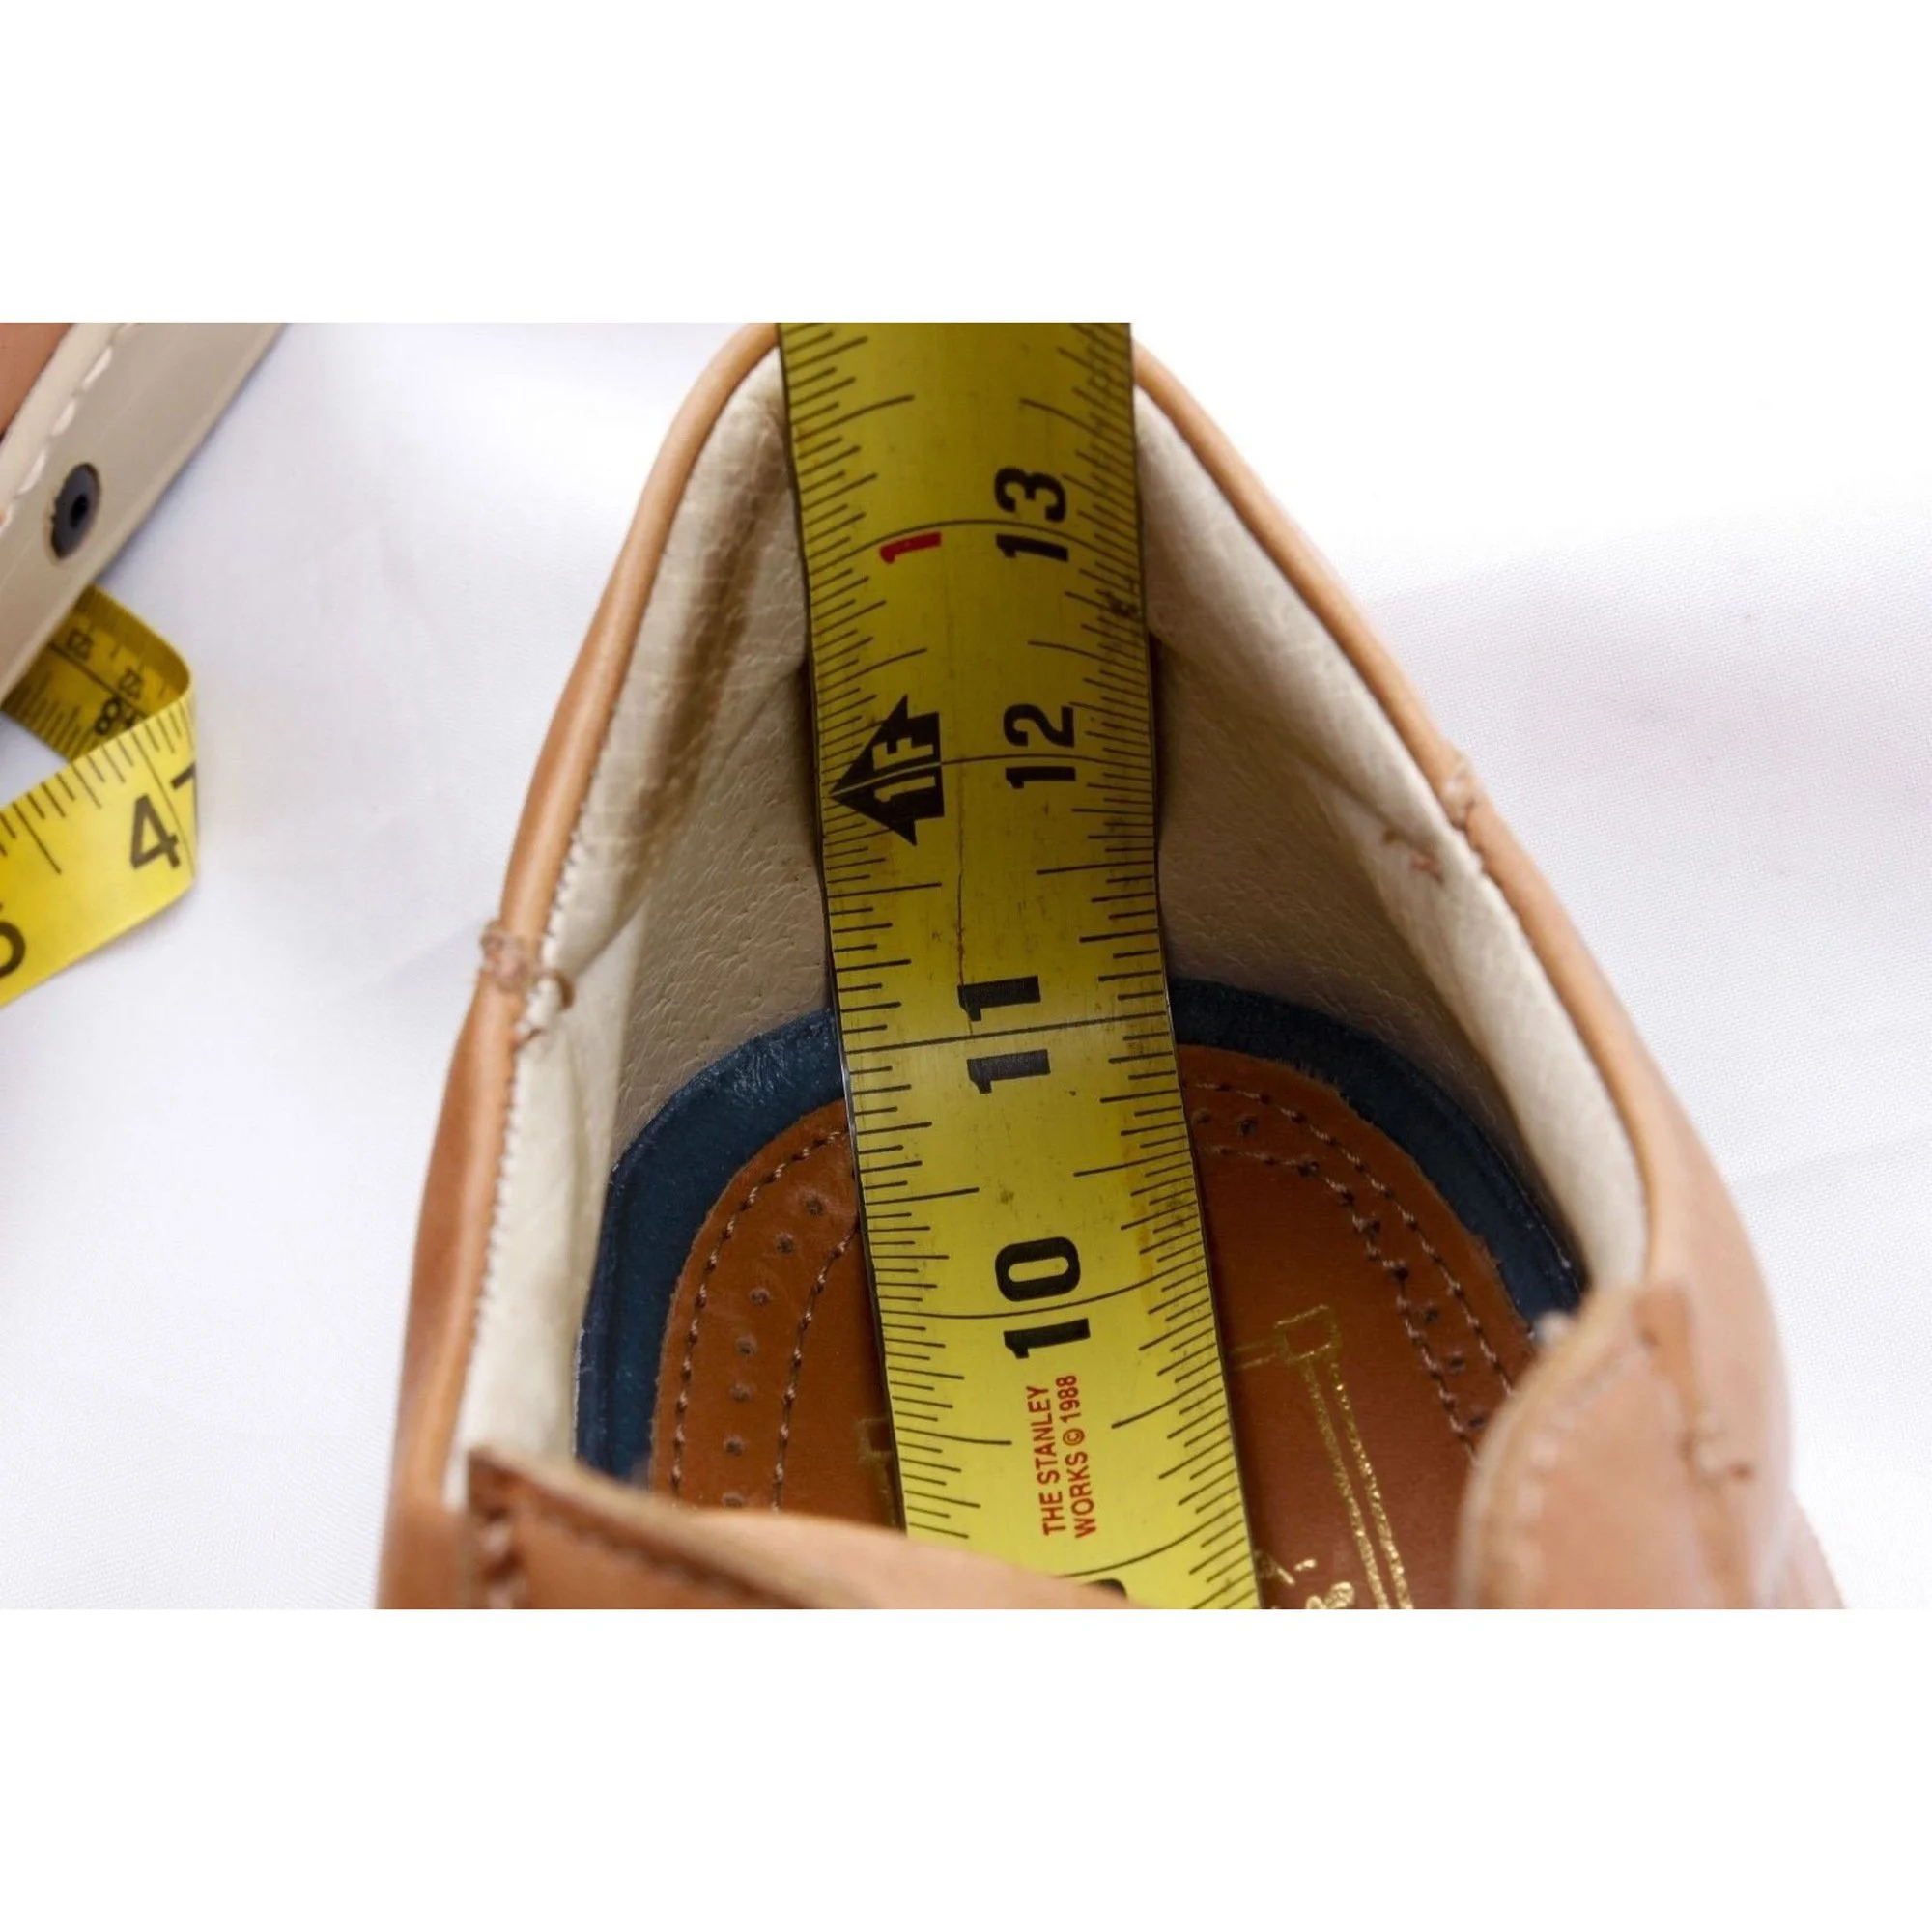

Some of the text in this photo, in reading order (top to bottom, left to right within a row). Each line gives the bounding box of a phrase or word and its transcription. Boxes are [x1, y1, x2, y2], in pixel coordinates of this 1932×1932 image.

[879, 531, 942, 564] 1
[994, 467, 1068, 562] 13
[1004, 703, 1076, 789] 12
[957, 975, 1051, 1094] 11
[995, 1236, 1091, 1359] 10
[1056, 1375, 1082, 1424] 1988
[1026, 1385, 1066, 1536] THE STANLEY
[1065, 1451, 1097, 1539] WORKS
